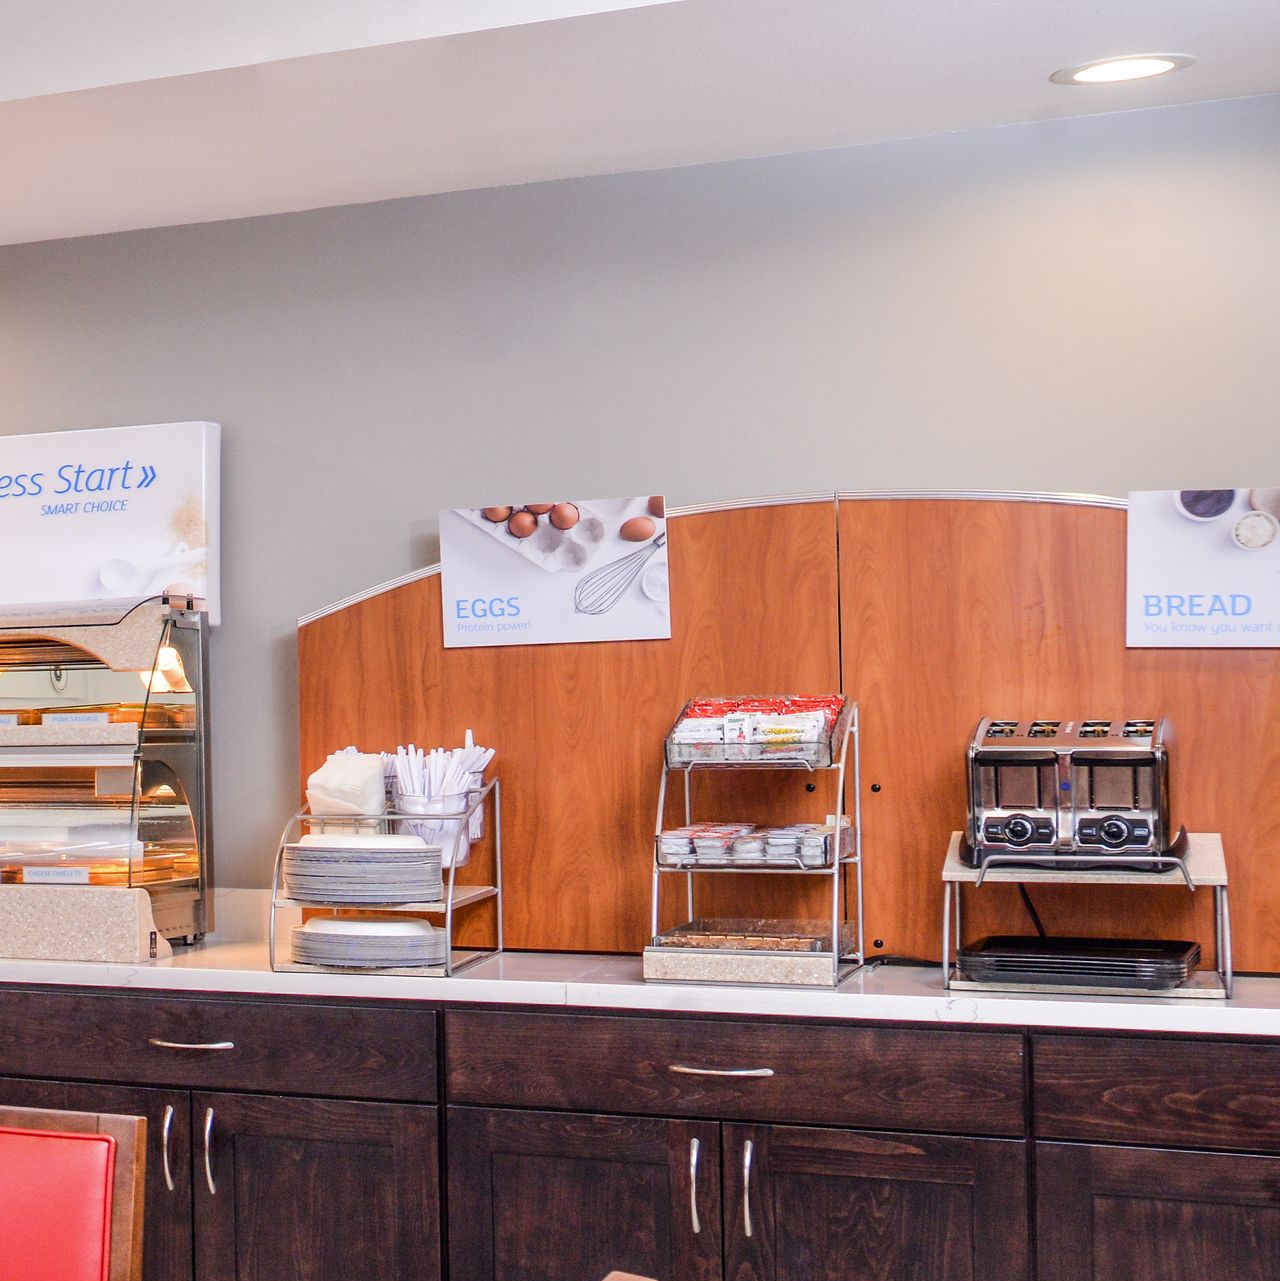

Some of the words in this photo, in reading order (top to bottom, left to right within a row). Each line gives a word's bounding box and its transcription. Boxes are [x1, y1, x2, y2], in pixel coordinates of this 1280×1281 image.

[54, 461, 133, 494] Start
[40, 503, 80, 517] SMART
[83, 500, 128, 513] CHOICE
[456, 597, 520, 619] EGGS
[1143, 594, 1252, 616] BREAD
[457, 623, 493, 632] Protein
[497, 621, 531, 632] power!
[1143, 622, 1168, 632] You
[1172, 621, 1207, 632] know
[1211, 623, 1236, 634] you
[1240, 622, 1273, 632] want
